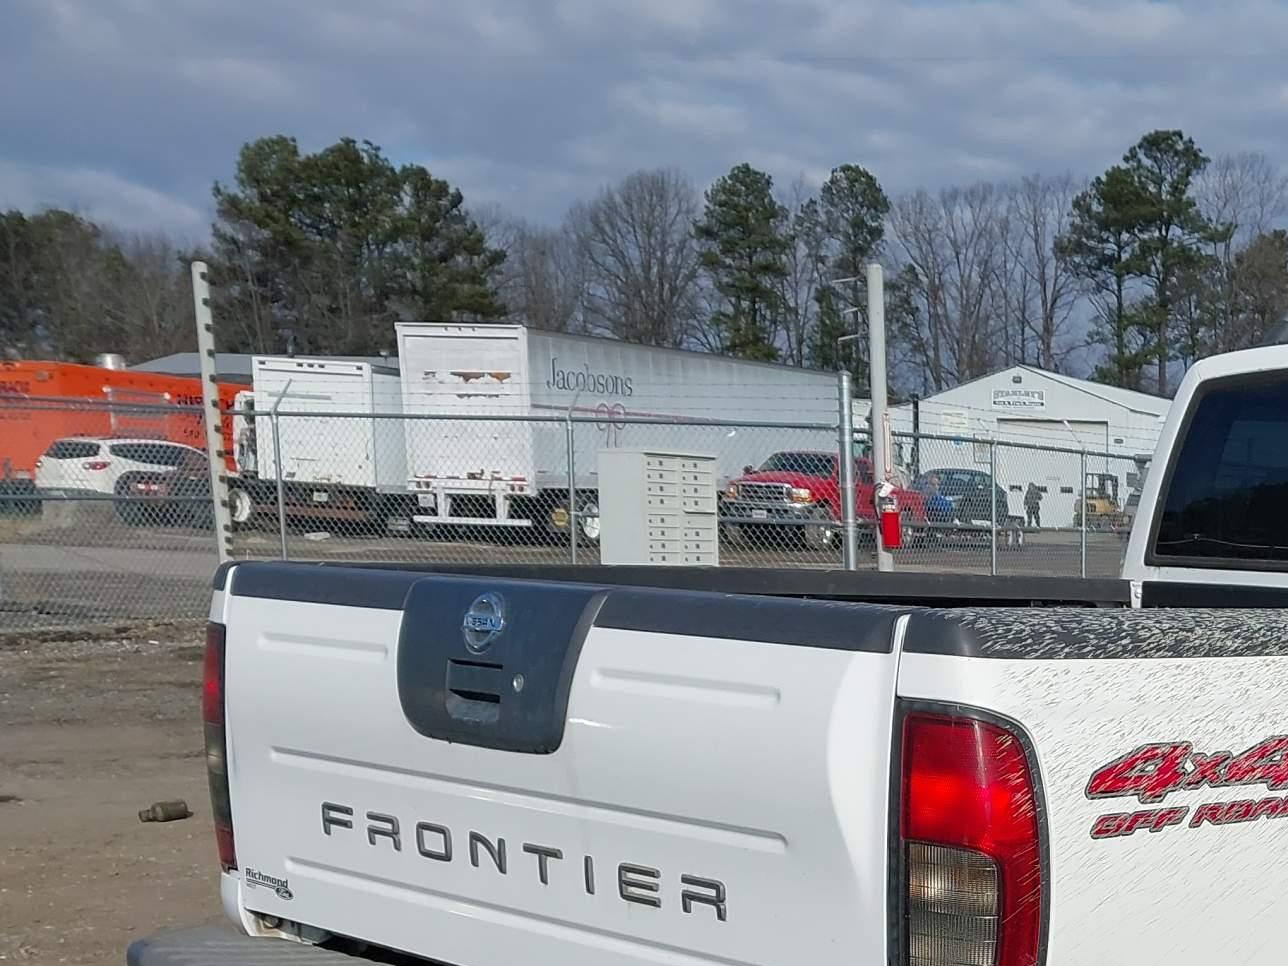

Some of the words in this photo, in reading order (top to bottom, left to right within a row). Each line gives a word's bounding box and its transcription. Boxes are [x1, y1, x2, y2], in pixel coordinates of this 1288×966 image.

[546, 357, 633, 397] Jacobsons
[1090, 806, 1190, 840] OFF
[245, 867, 289, 889] Richmond
[321, 801, 728, 922] FRONTIER
